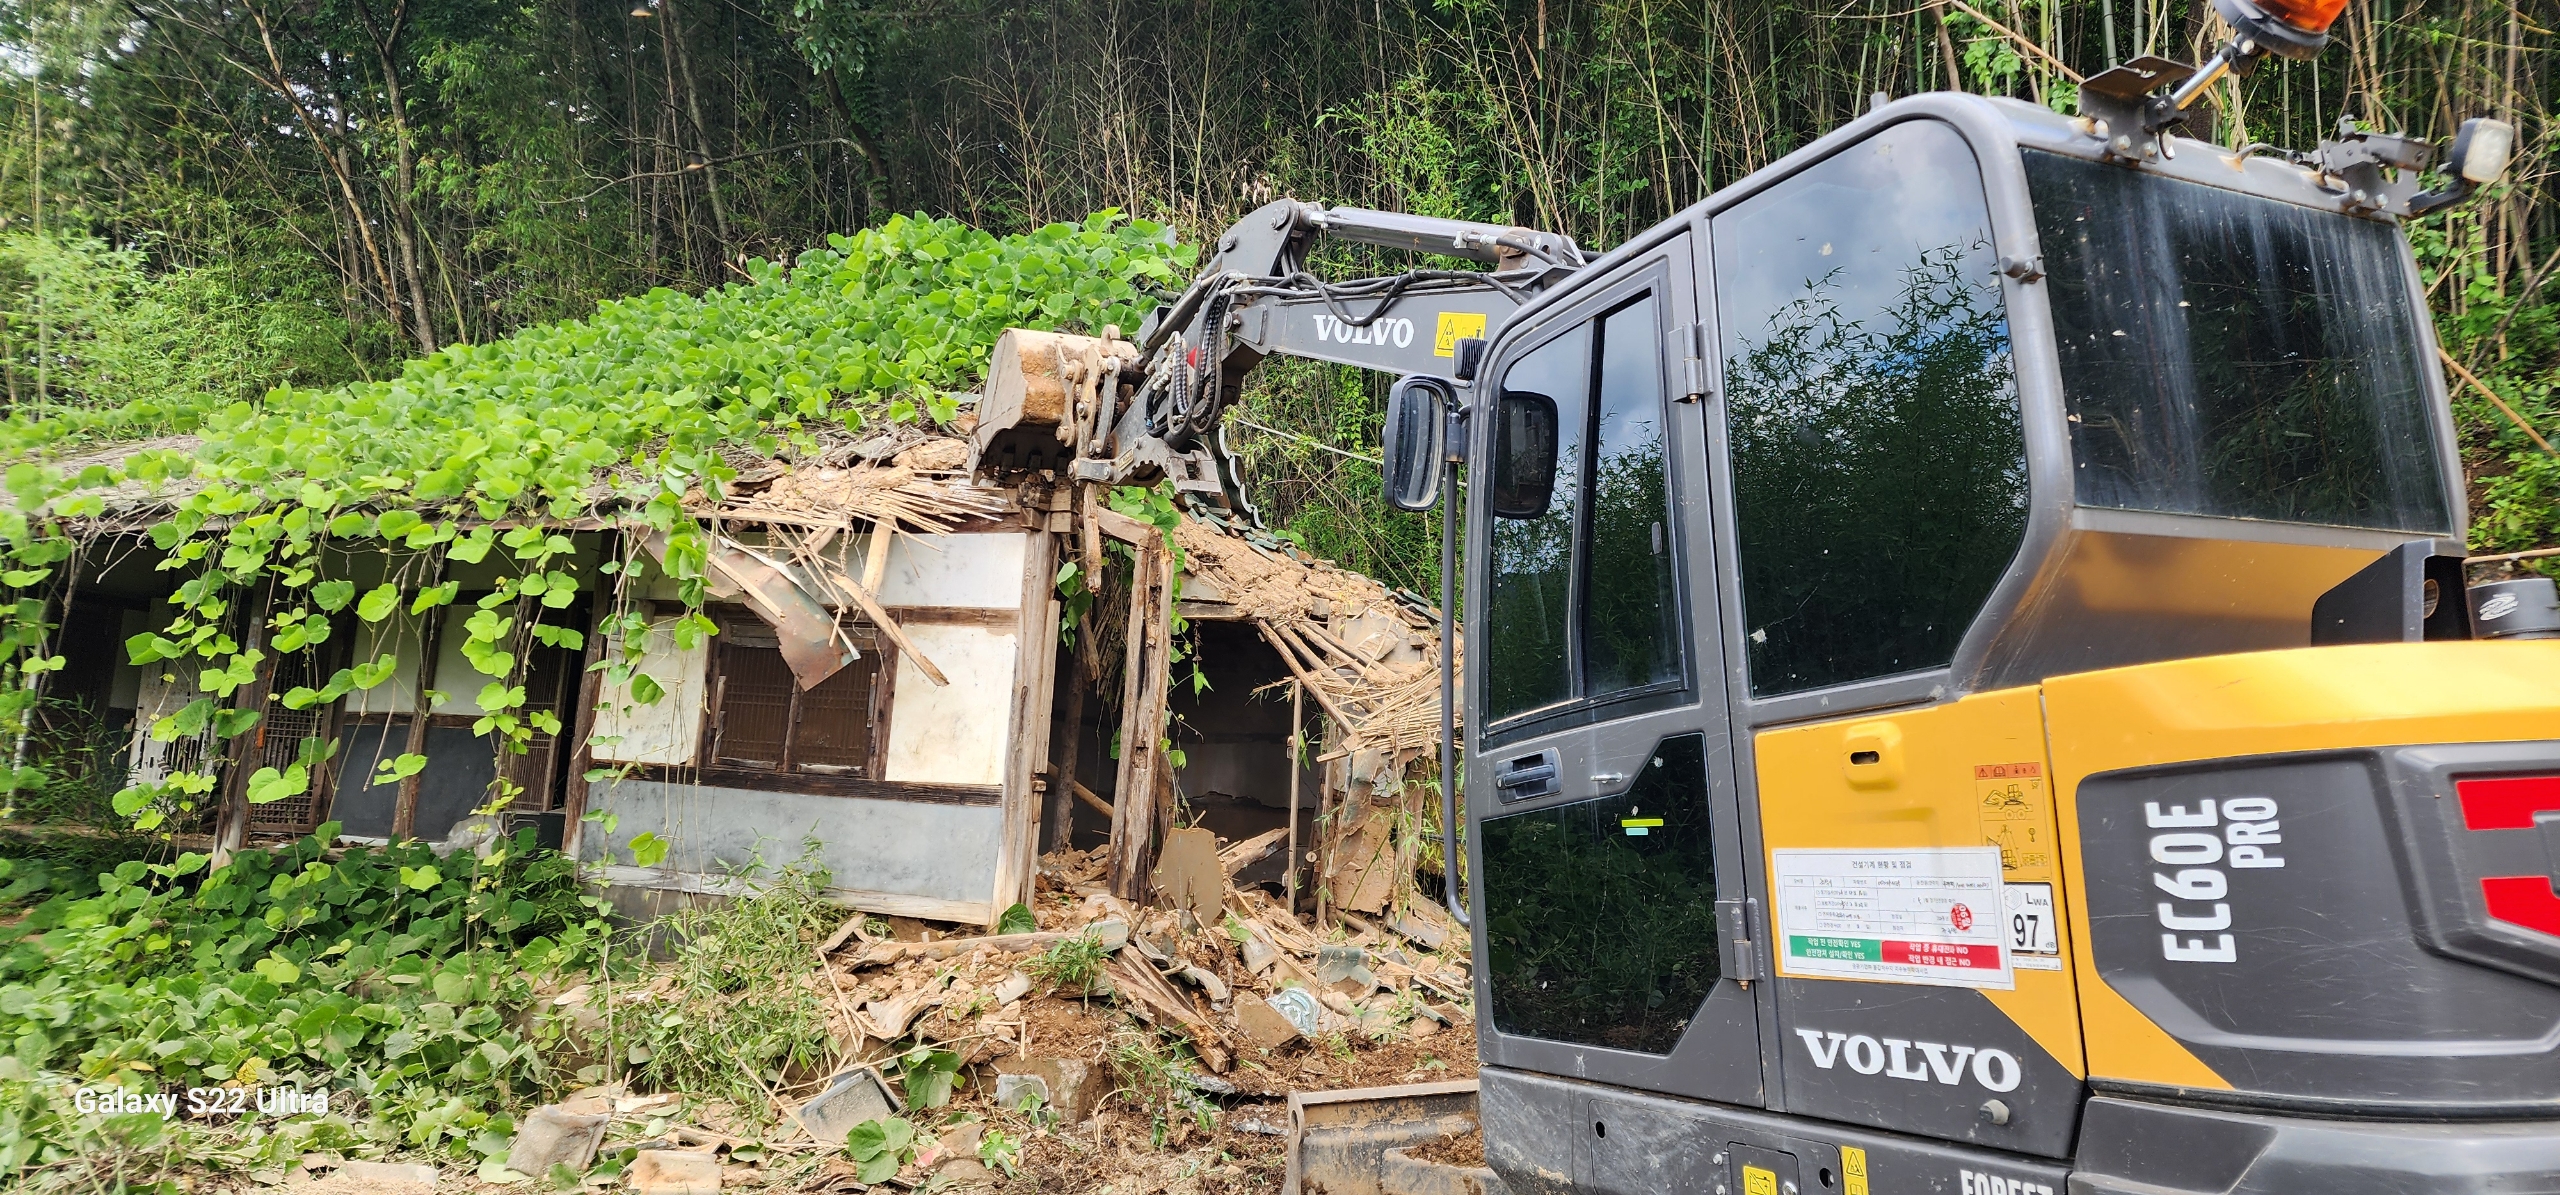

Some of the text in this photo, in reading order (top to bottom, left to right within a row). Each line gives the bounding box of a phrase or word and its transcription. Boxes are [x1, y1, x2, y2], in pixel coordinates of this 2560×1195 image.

[1312, 314, 1415, 348] VOLVO
[2221, 797, 2286, 869] PRO
[1851, 860, 1876, 869] 건설기계
[1891, 860, 1898, 869] 및
[2144, 799, 2237, 963] EC60E
[1807, 937, 1861, 949] 작업 전 안전확인 YES
[2013, 913, 2039, 948] 97
[1854, 952, 1865, 960] YES
[1908, 954, 1971, 967] 작업 반경 내 접근 NO
[1909, 943, 1969, 955] 작업 중 휴대전화 NO
[1796, 1028, 2022, 1093] VOLVO
[1960, 1169, 2053, 1195] FOR
